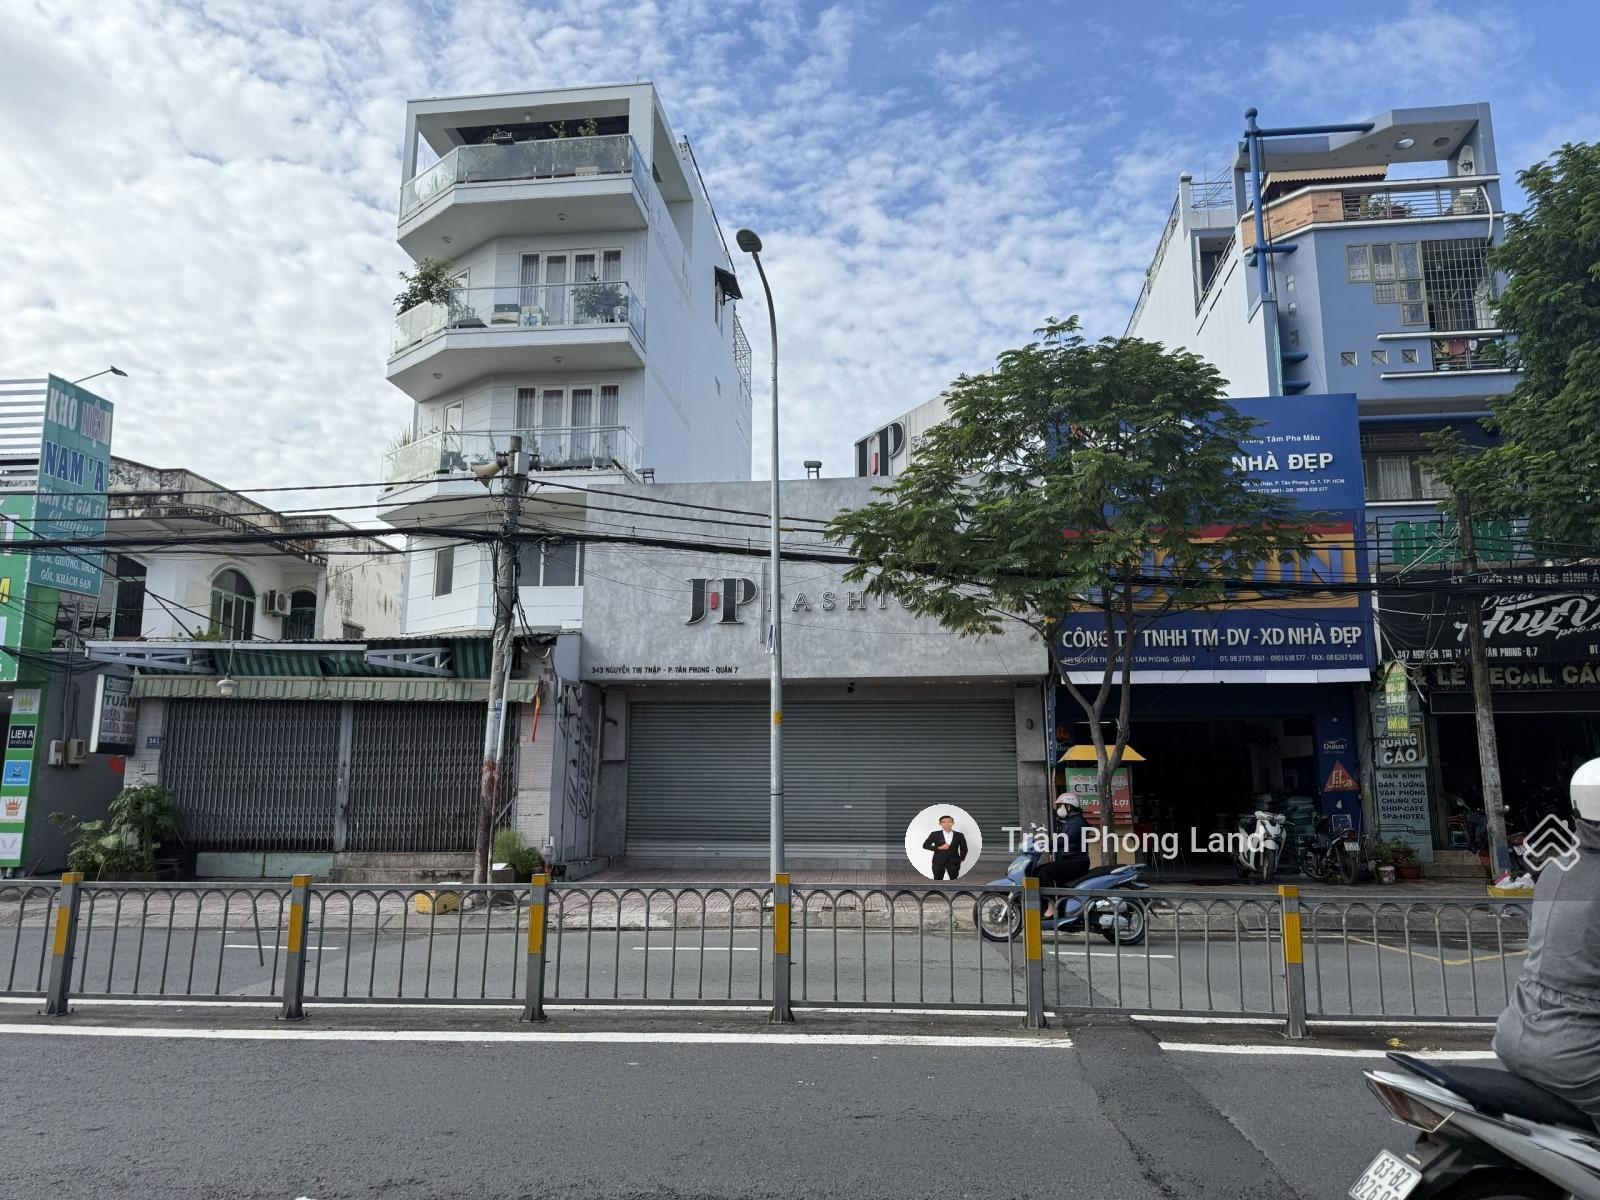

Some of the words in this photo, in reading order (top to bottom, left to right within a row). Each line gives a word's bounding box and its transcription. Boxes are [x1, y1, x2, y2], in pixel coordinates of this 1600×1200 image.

[48, 387, 78, 430] KHO
[1266, 434, 1284, 443] Tâm
[43, 440, 86, 487] NAM
[1232, 451, 1279, 472] NHÀ
[1288, 452, 1334, 473] ĐẸP
[1062, 626, 1109, 648] CÔNG
[1142, 629, 1187, 647] TNHH
[1288, 622, 1326, 645] NHÀ
[1329, 626, 1362, 648] ĐẸP
[1134, 654, 1147, 663] TÂN
[1148, 655, 1170, 663] PHONG
[1172, 655, 1190, 664] QUẬN
[1500, 647, 1522, 657] PHONG
[591, 666, 604, 674] 343
[605, 664, 630, 674] NGUYỄN
[632, 666, 642, 675] THỊ
[644, 665, 662, 675] THẬP
[674, 665, 687, 674] TÂN
[688, 665, 710, 674] PHONG
[715, 665, 733, 675] QUẬN
[1383, 748, 1418, 764] CÁO
